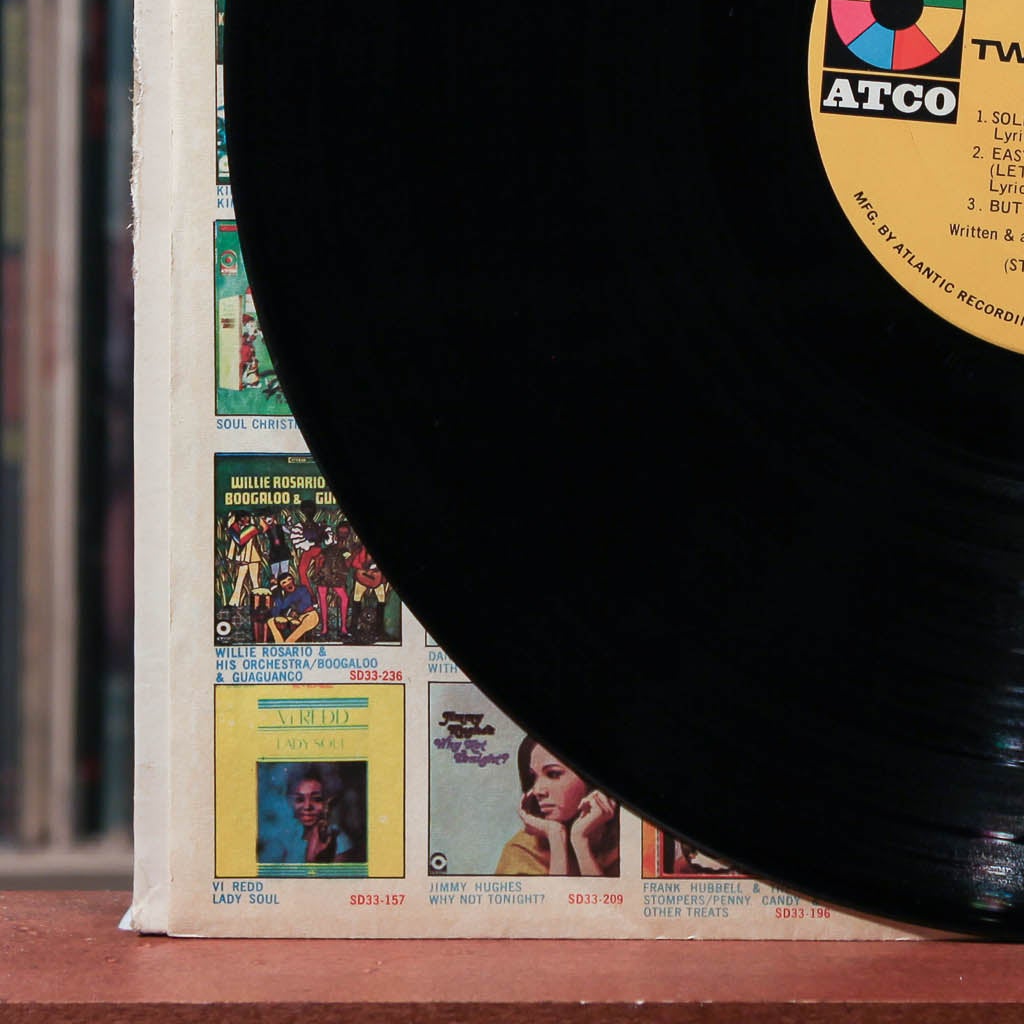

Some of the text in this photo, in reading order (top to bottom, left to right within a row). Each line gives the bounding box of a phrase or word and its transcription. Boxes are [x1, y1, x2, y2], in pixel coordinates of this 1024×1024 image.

[822, 78, 957, 116] ATCO
[976, 109, 987, 123] 1.
[972, 146, 984, 159] 2.
[949, 223, 998, 241] Written
[1003, 228, 1014, 242] &
[853, 190, 879, 226] MFG.
[877, 223, 897, 242] BY
[893, 242, 956, 294] ATLANTIC
[216, 418, 247, 430] SOUL
[231, 476, 326, 489] WILLIE ROSARIO
[224, 492, 290, 505] BOOGALOO
[293, 494, 302, 505] &
[215, 646, 327, 658] WILLIE ROSARIO &
[215, 658, 378, 670] HIS ORCHESTRA/BOOGALOO
[428, 663, 458, 673] WITH
[215, 671, 303, 683] & GUAGUANCO
[349, 670, 403, 681] SD33-236
[212, 881, 264, 893] VI REDD
[428, 881, 522, 893] JIMMY HUGHES
[642, 882, 681, 893] FRANK
[690, 882, 743, 894] HUBBELL
[752, 882, 761, 893] &
[212, 893, 280, 905] LADY SOUL
[349, 894, 406, 906] SD33-157
[428, 893, 545, 905] WHY NOT TONIGHT?
[567, 893, 624, 905] SD33-209
[642, 894, 751, 906] STOMPERS/PENNY
[761, 894, 800, 906] CANDY
[643, 907, 729, 918] OTHER TREATS
[775, 907, 831, 919] SD33-196
